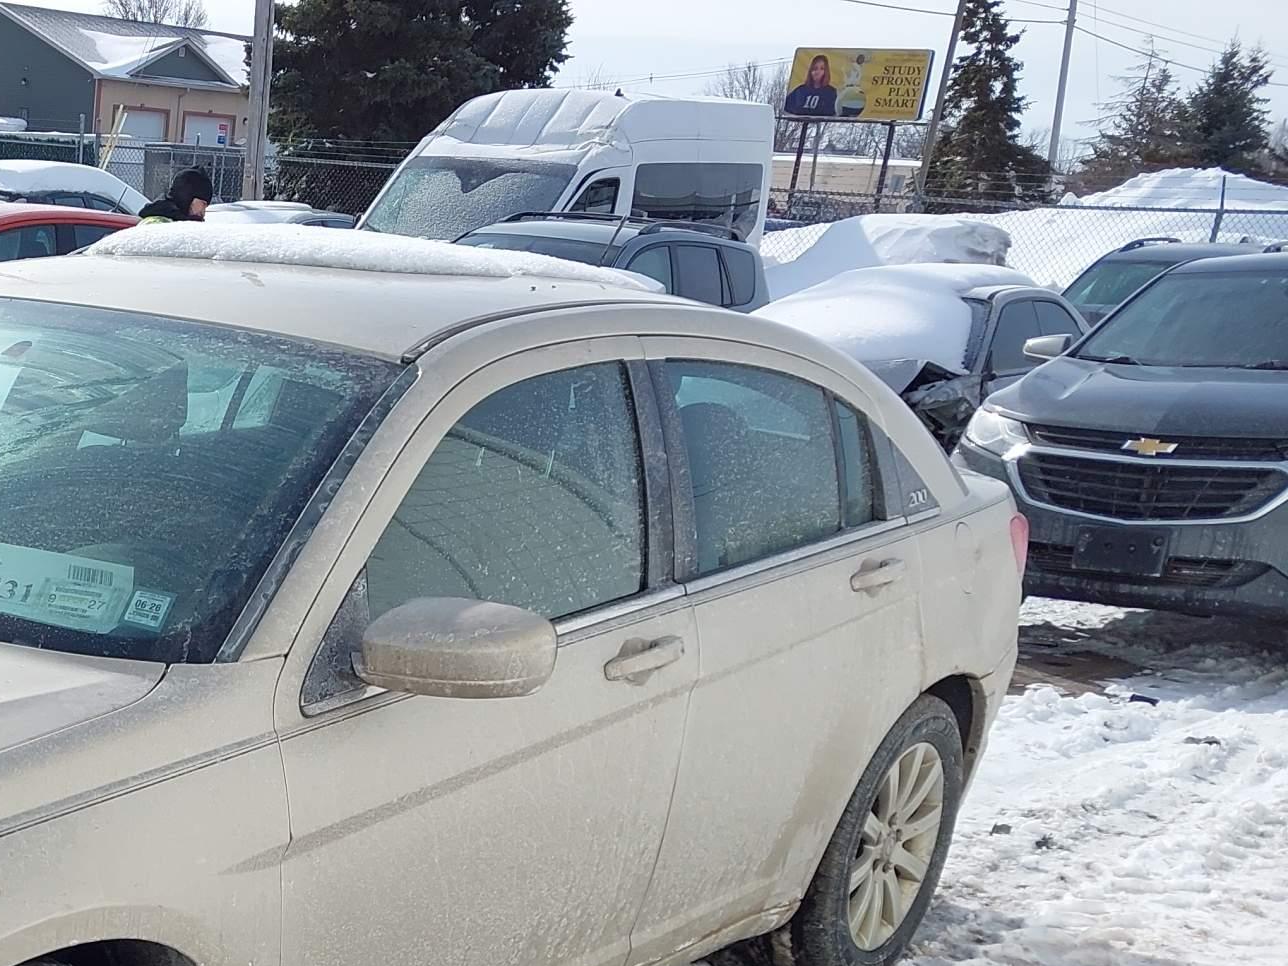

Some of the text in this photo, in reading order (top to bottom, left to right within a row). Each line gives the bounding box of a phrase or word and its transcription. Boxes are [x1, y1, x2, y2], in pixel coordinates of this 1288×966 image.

[883, 65, 924, 75] STUDY
[871, 76, 921, 86] STRONG
[888, 87, 920, 97] PLAY
[803, 95, 819, 108] 10
[874, 97, 917, 108] SMART
[47, 593, 57, 603] 9
[88, 599, 106, 610] 27
